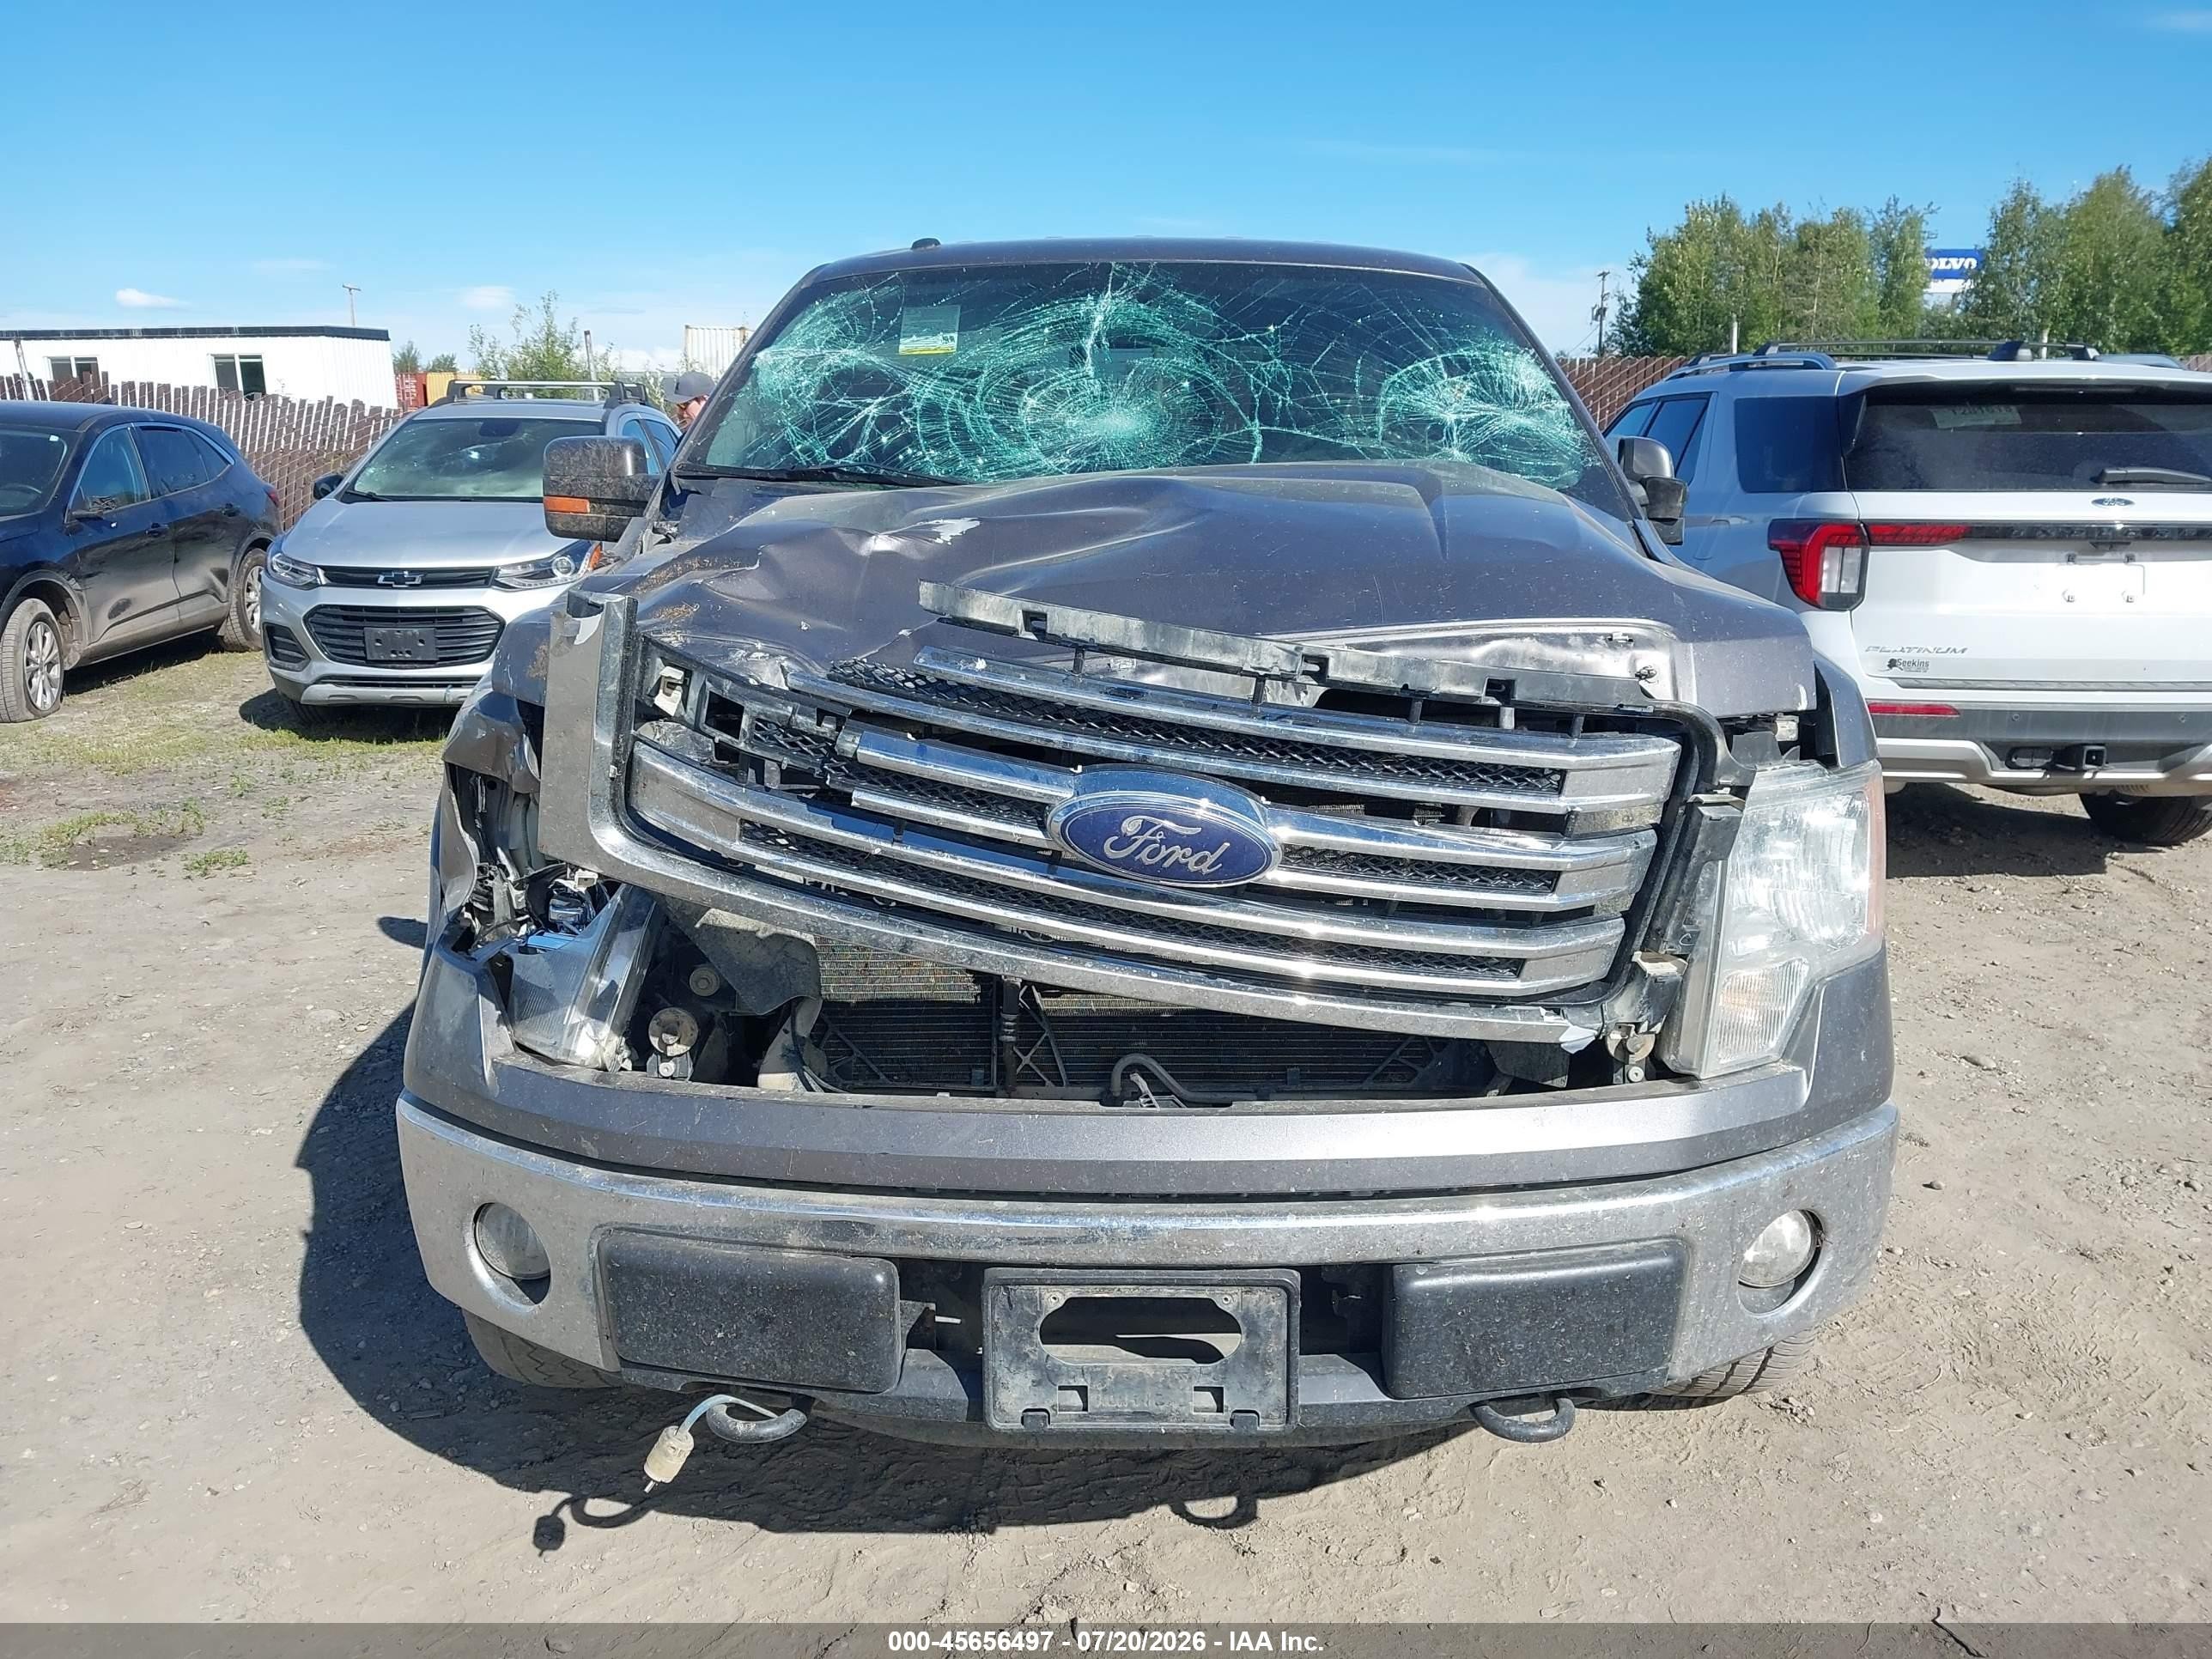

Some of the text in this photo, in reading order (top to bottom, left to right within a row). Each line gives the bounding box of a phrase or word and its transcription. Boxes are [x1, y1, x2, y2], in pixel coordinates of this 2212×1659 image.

[1924, 257, 1978, 270] OLVO
[1865, 645, 1968, 654] PLATINUM
[1897, 658, 1930, 667] Seekins
[1103, 815, 1231, 874] Ford
